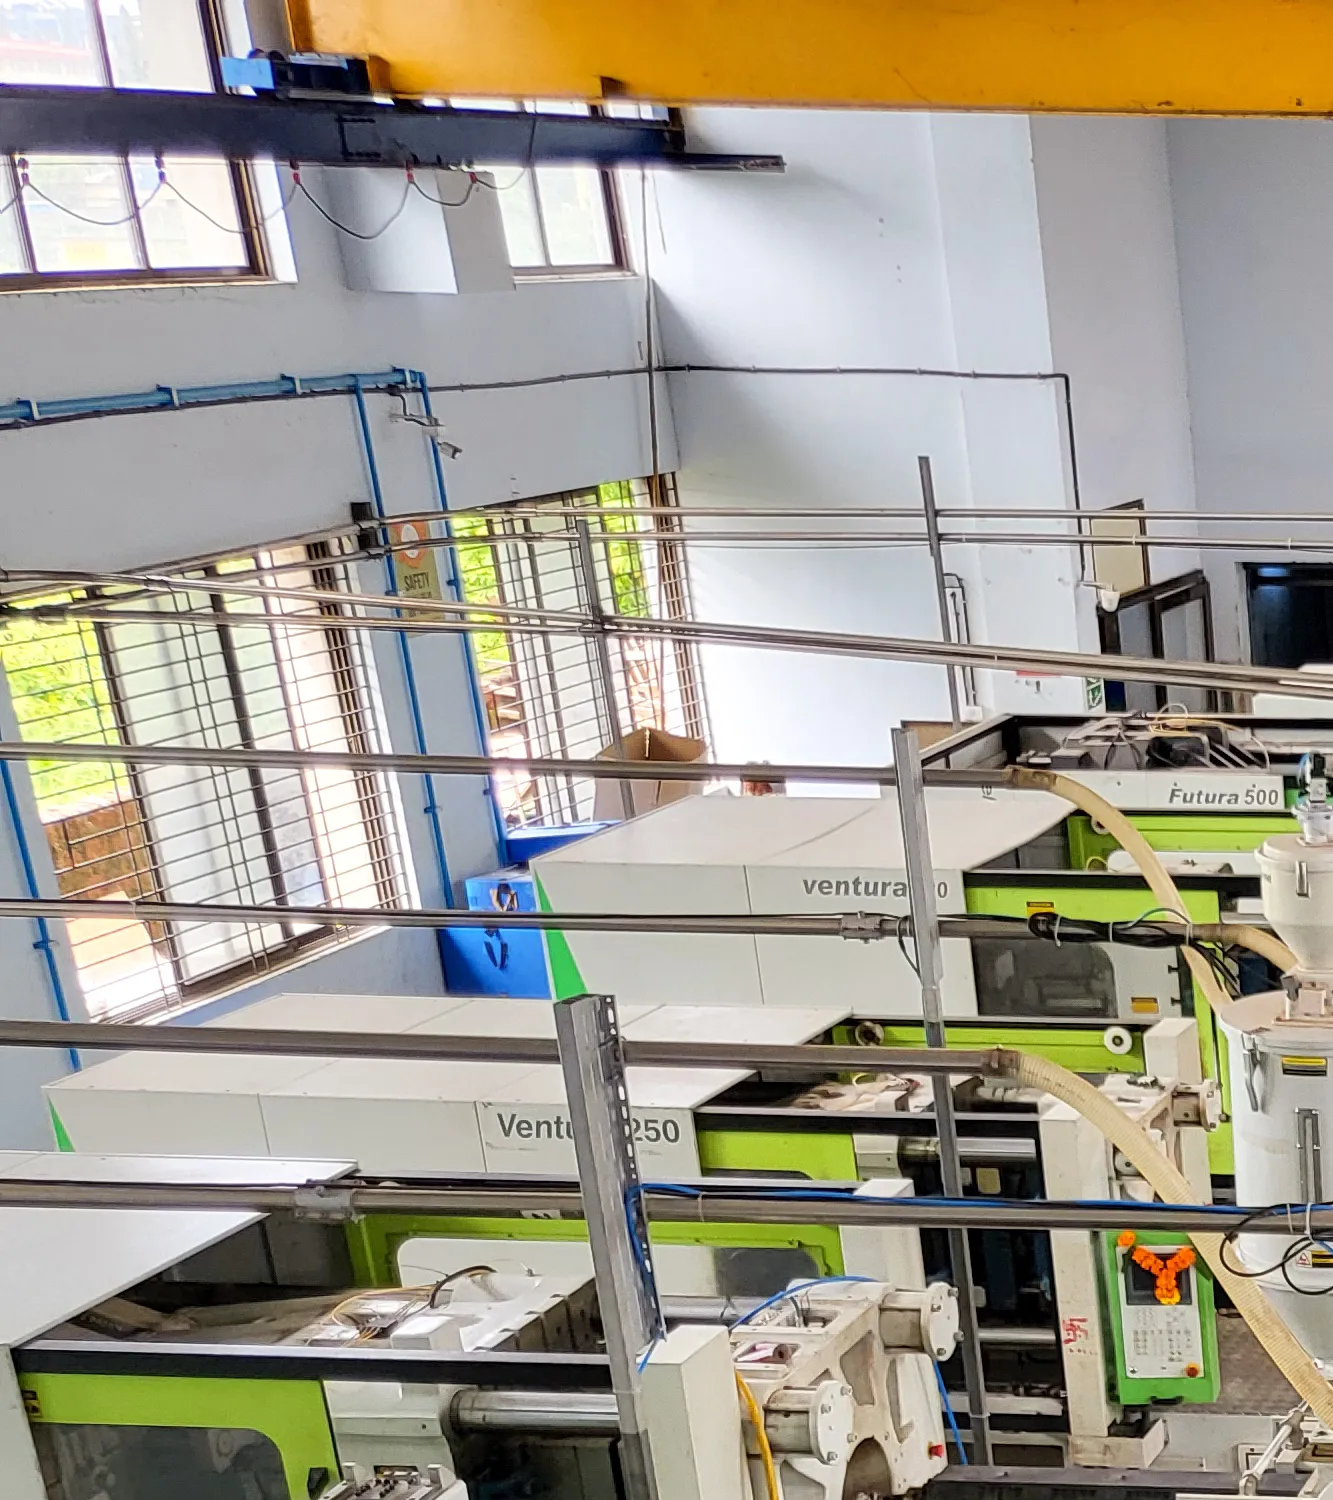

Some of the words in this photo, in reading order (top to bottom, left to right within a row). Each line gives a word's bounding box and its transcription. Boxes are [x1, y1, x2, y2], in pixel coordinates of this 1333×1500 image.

[404, 572, 430, 592] SAFETY
[1169, 788, 1239, 804] Futura
[1244, 789, 1279, 805] 500
[803, 876, 907, 898] ventura
